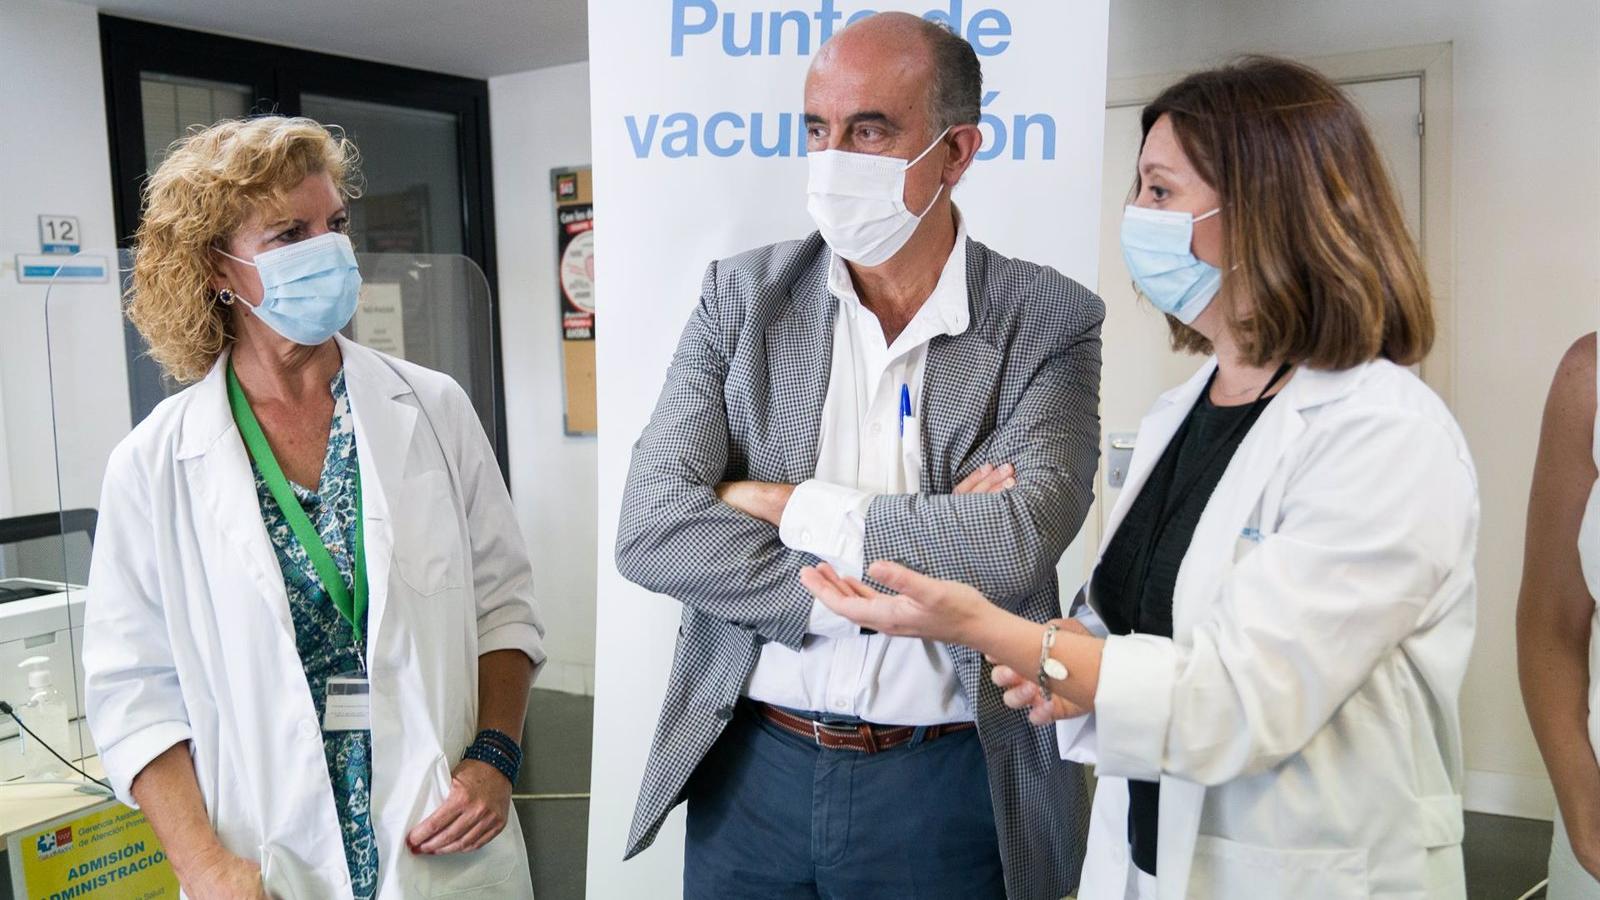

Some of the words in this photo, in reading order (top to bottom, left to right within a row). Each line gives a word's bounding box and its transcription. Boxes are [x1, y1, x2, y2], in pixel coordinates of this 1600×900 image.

[670, 0, 879, 57] Punt
[624, 91, 1056, 161] vacuón
[46, 220, 74, 241] 12
[78, 819, 113, 836] Gerencia
[79, 839, 89, 848] de
[91, 827, 124, 843] Atención
[41, 849, 168, 900] DMINISTRACIÓ
[68, 841, 145, 881] ADMISIÓN
